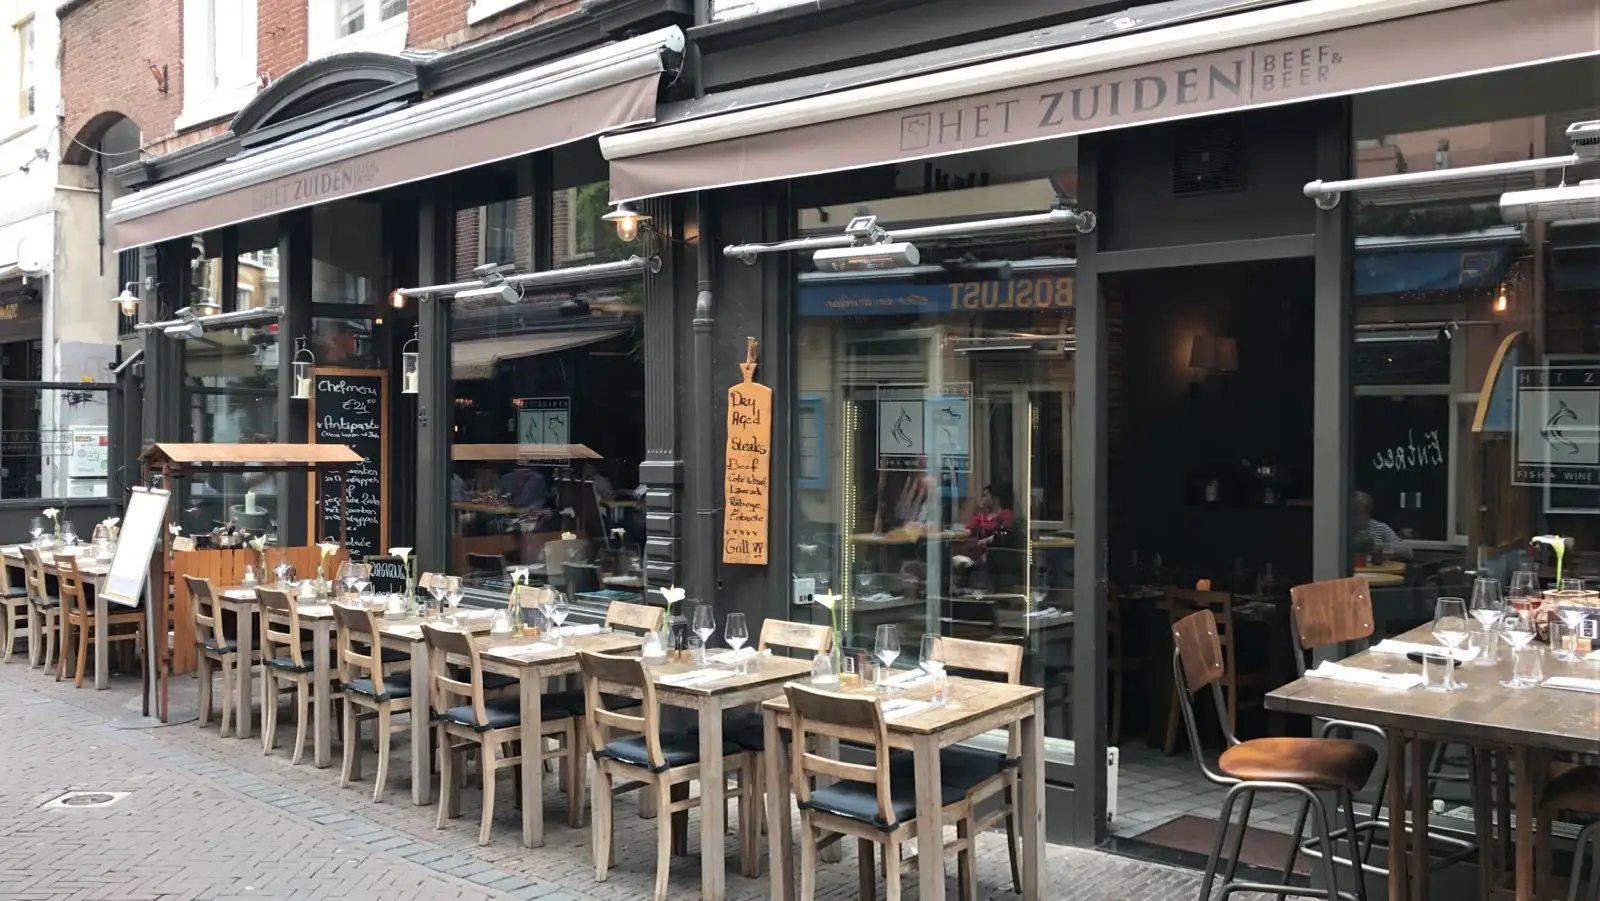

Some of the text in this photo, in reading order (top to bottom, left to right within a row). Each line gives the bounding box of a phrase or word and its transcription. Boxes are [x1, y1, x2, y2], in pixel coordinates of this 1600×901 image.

[1263, 68, 1330, 91] BEER
[939, 59, 1246, 145] HET ZUIDEN
[264, 165, 353, 209] HET ZUIDEN
[732, 409, 760, 429] Aged
[732, 436, 767, 455] Steaks
[727, 458, 759, 473] Beef
[1564, 471, 1593, 481] WINE
[726, 538, 749, 554] Grill
